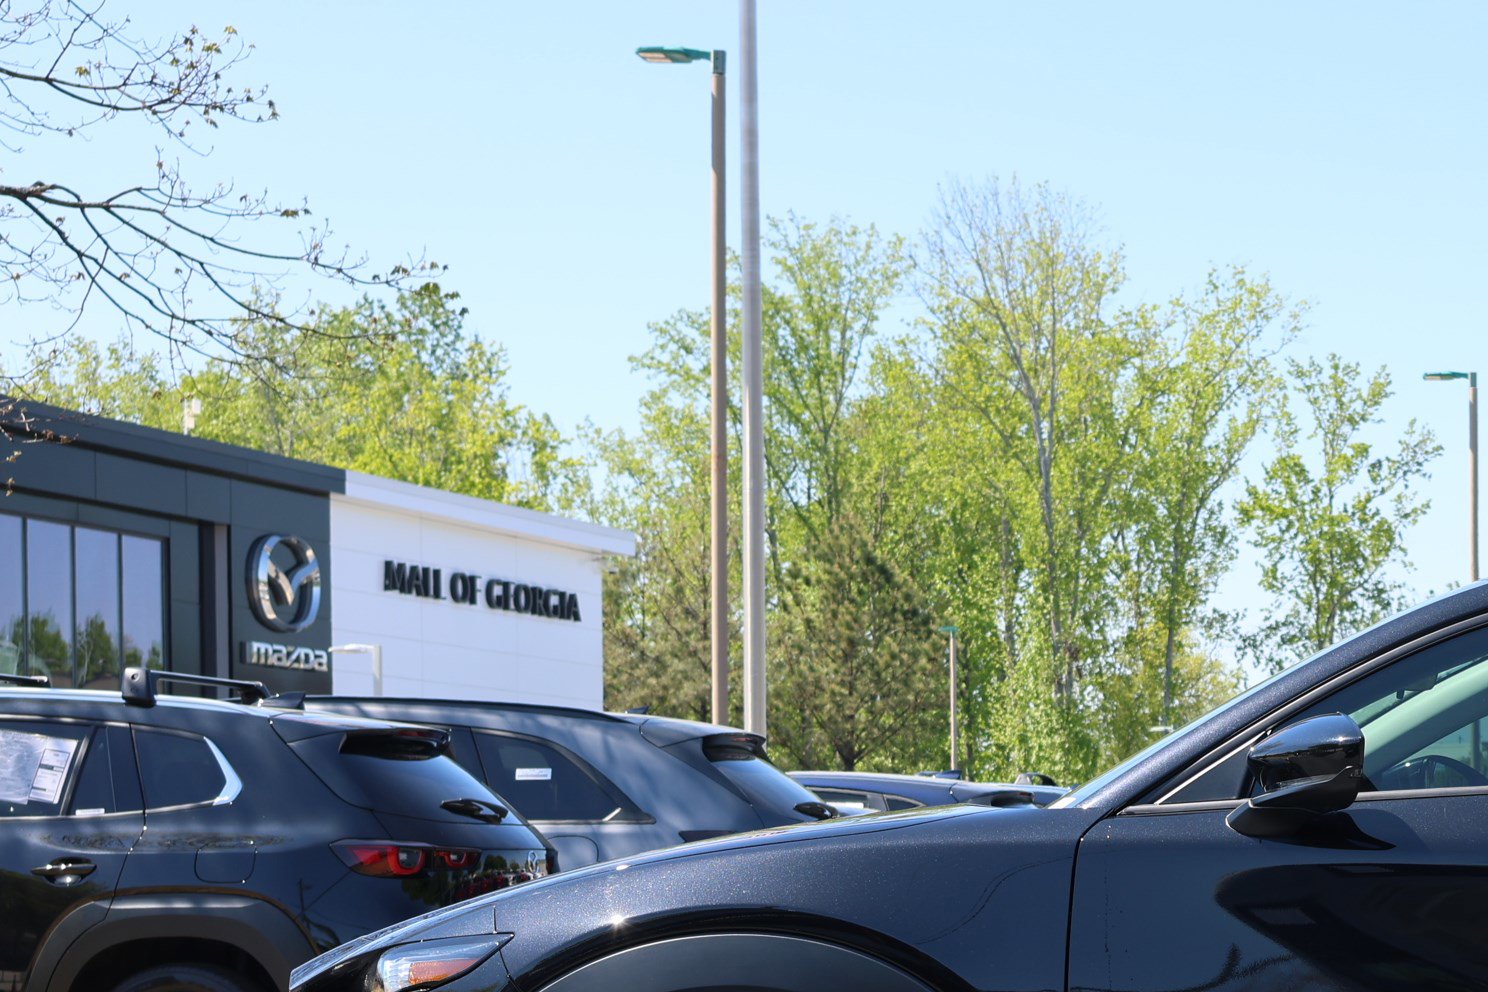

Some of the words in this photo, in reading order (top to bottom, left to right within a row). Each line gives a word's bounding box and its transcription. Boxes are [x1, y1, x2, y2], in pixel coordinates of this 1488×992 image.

[384, 560, 446, 600] MALL
[450, 572, 482, 606] OF
[485, 579, 582, 622] GEORGIA
